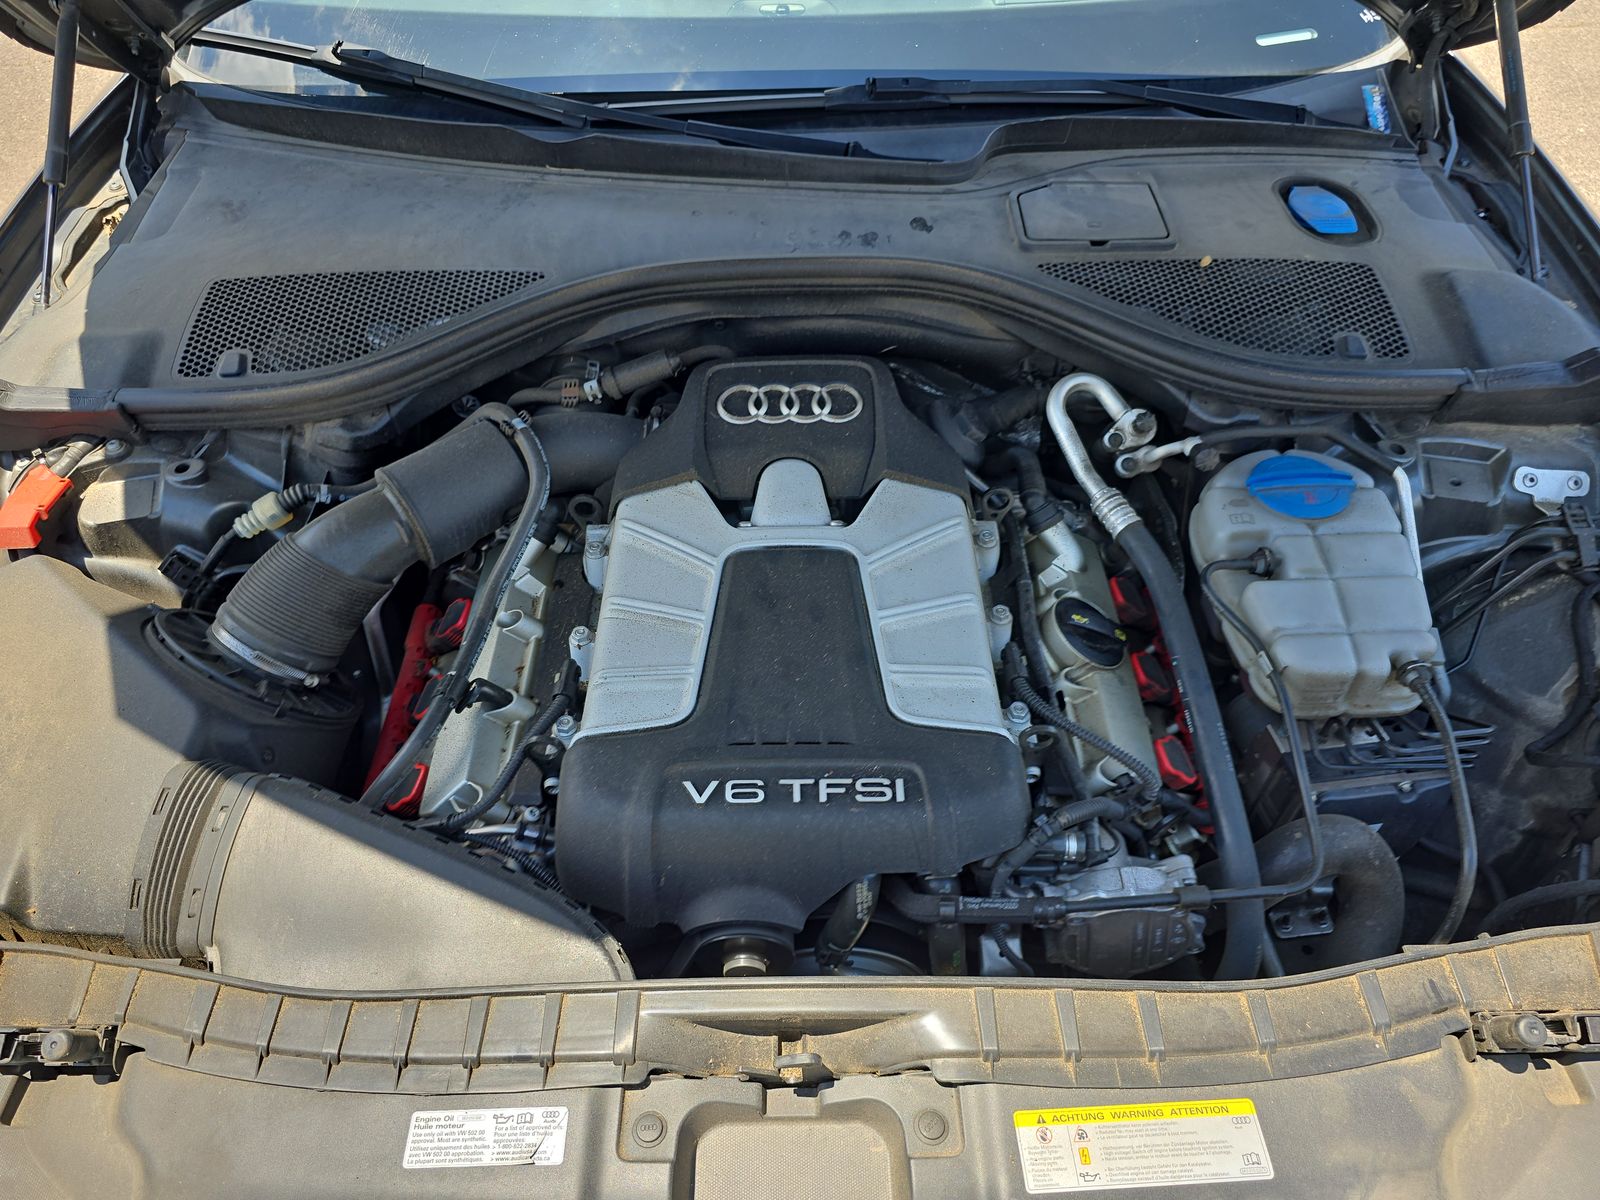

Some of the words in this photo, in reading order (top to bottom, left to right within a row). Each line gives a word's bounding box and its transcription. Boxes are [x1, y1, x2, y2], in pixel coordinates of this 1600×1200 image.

[682, 779, 765, 804] V6
[778, 777, 905, 803] TFSI
[1052, 1112, 1105, 1123] ACHTUNG
[1110, 1109, 1164, 1120] WARNING
[1170, 1105, 1229, 1116] ATTENTION
